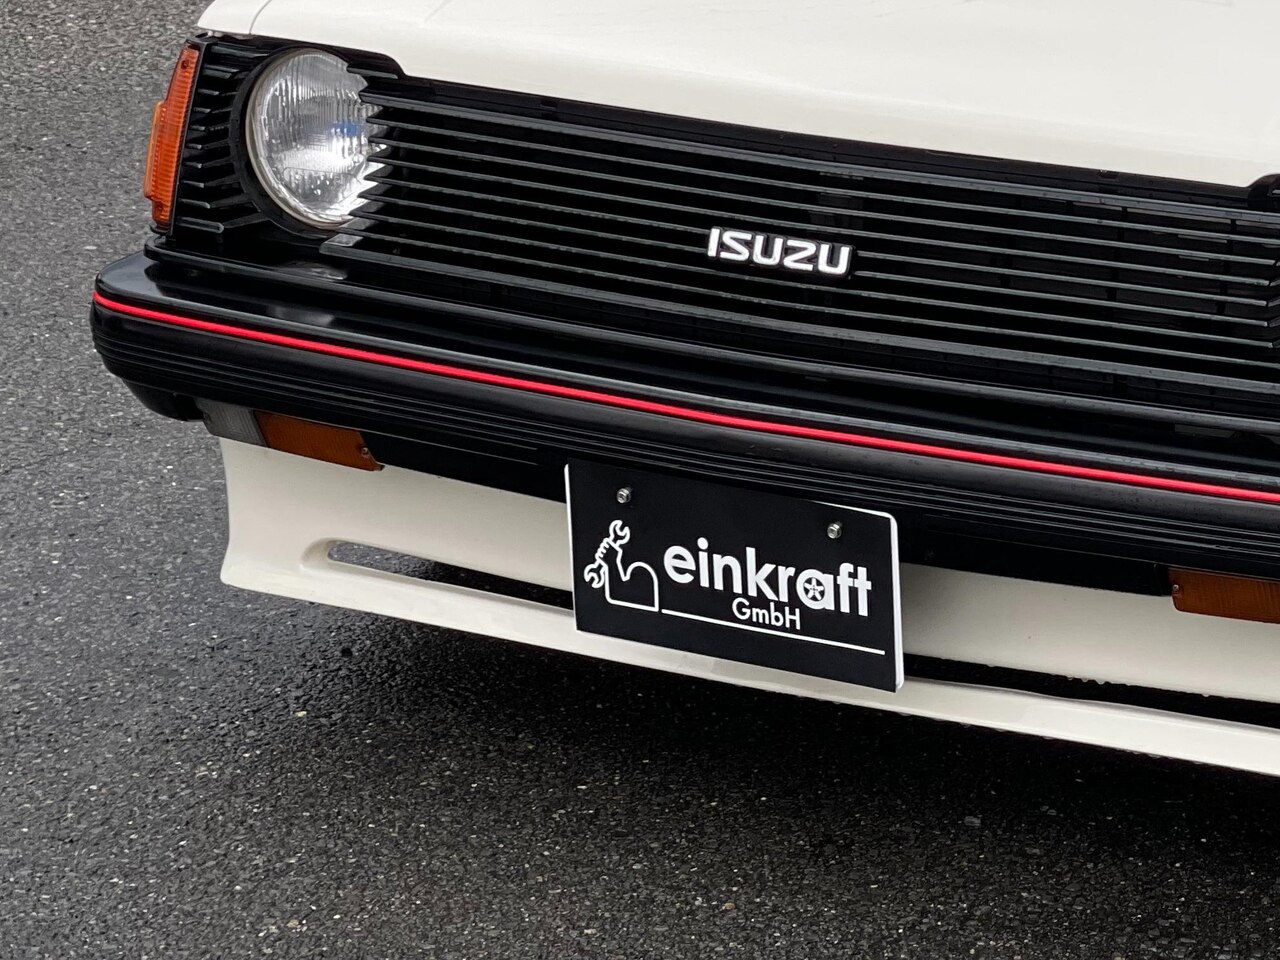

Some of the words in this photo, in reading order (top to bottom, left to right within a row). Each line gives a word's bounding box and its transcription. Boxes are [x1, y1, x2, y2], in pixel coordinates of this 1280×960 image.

[707, 227, 851, 276] ISUZU
[663, 537, 872, 617] einkraft
[732, 597, 801, 631] GmbH
